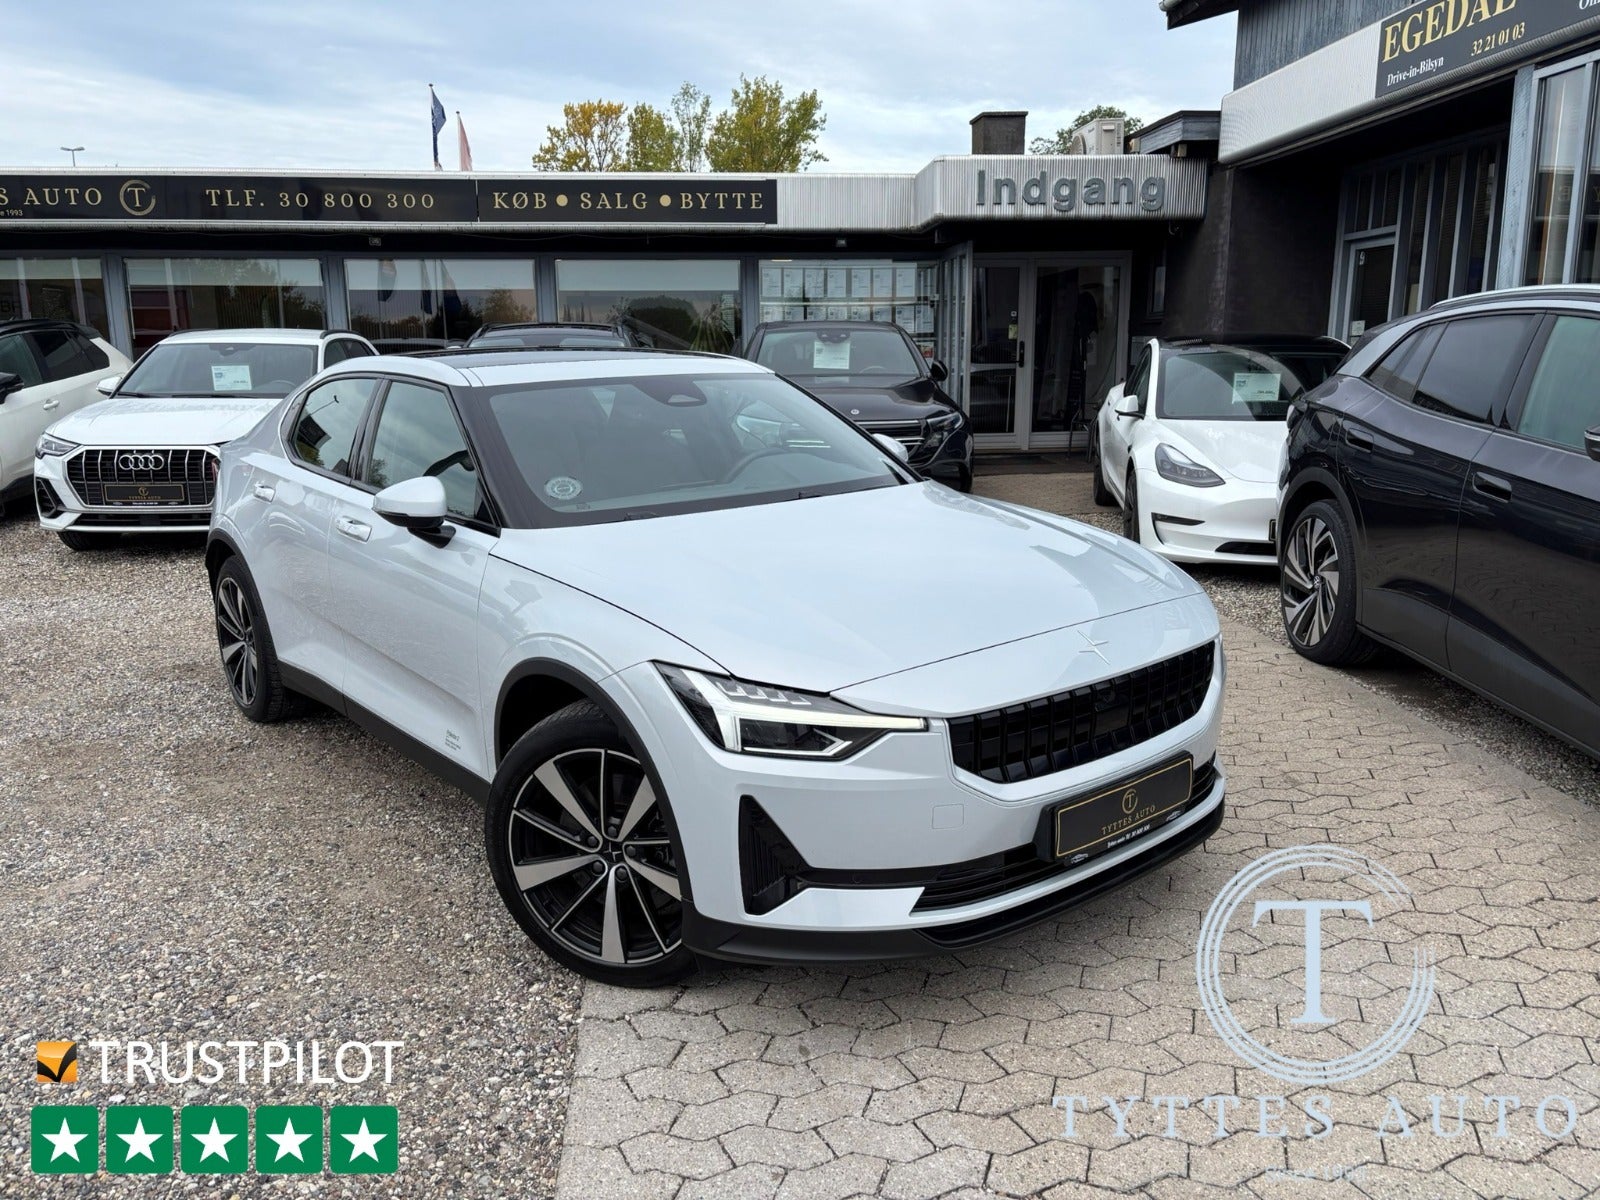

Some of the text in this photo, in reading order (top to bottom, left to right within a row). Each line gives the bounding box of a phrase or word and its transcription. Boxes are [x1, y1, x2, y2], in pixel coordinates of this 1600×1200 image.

[1471, 21, 1526, 57] 32 21 01 03
[23, 187, 102, 206] AUTO
[205, 189, 434, 209] TLF. 30 800 300
[493, 191, 764, 210] KØB SALG BYTTE
[976, 169, 1166, 212] Indgang
[1101, 805, 1156, 835] TYTTES AUTO
